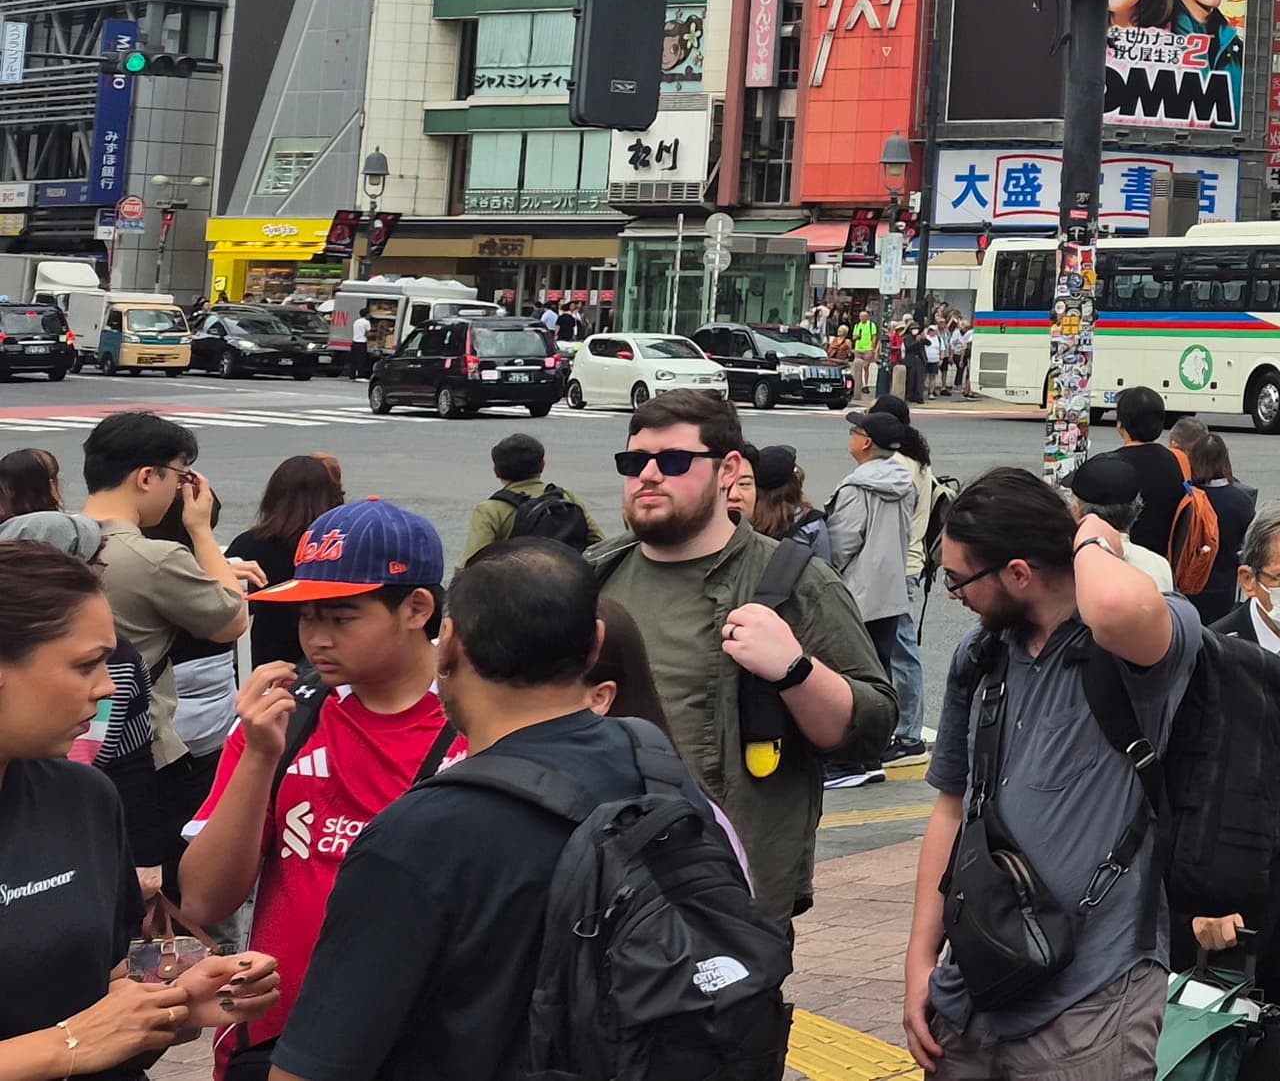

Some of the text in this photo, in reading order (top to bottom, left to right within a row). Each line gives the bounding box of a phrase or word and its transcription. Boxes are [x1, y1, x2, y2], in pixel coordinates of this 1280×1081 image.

[1112, 45, 1181, 65] 殺し屋生活
[1181, 33, 1212, 68] 2
[0, 871, 77, 906] Sportswear
